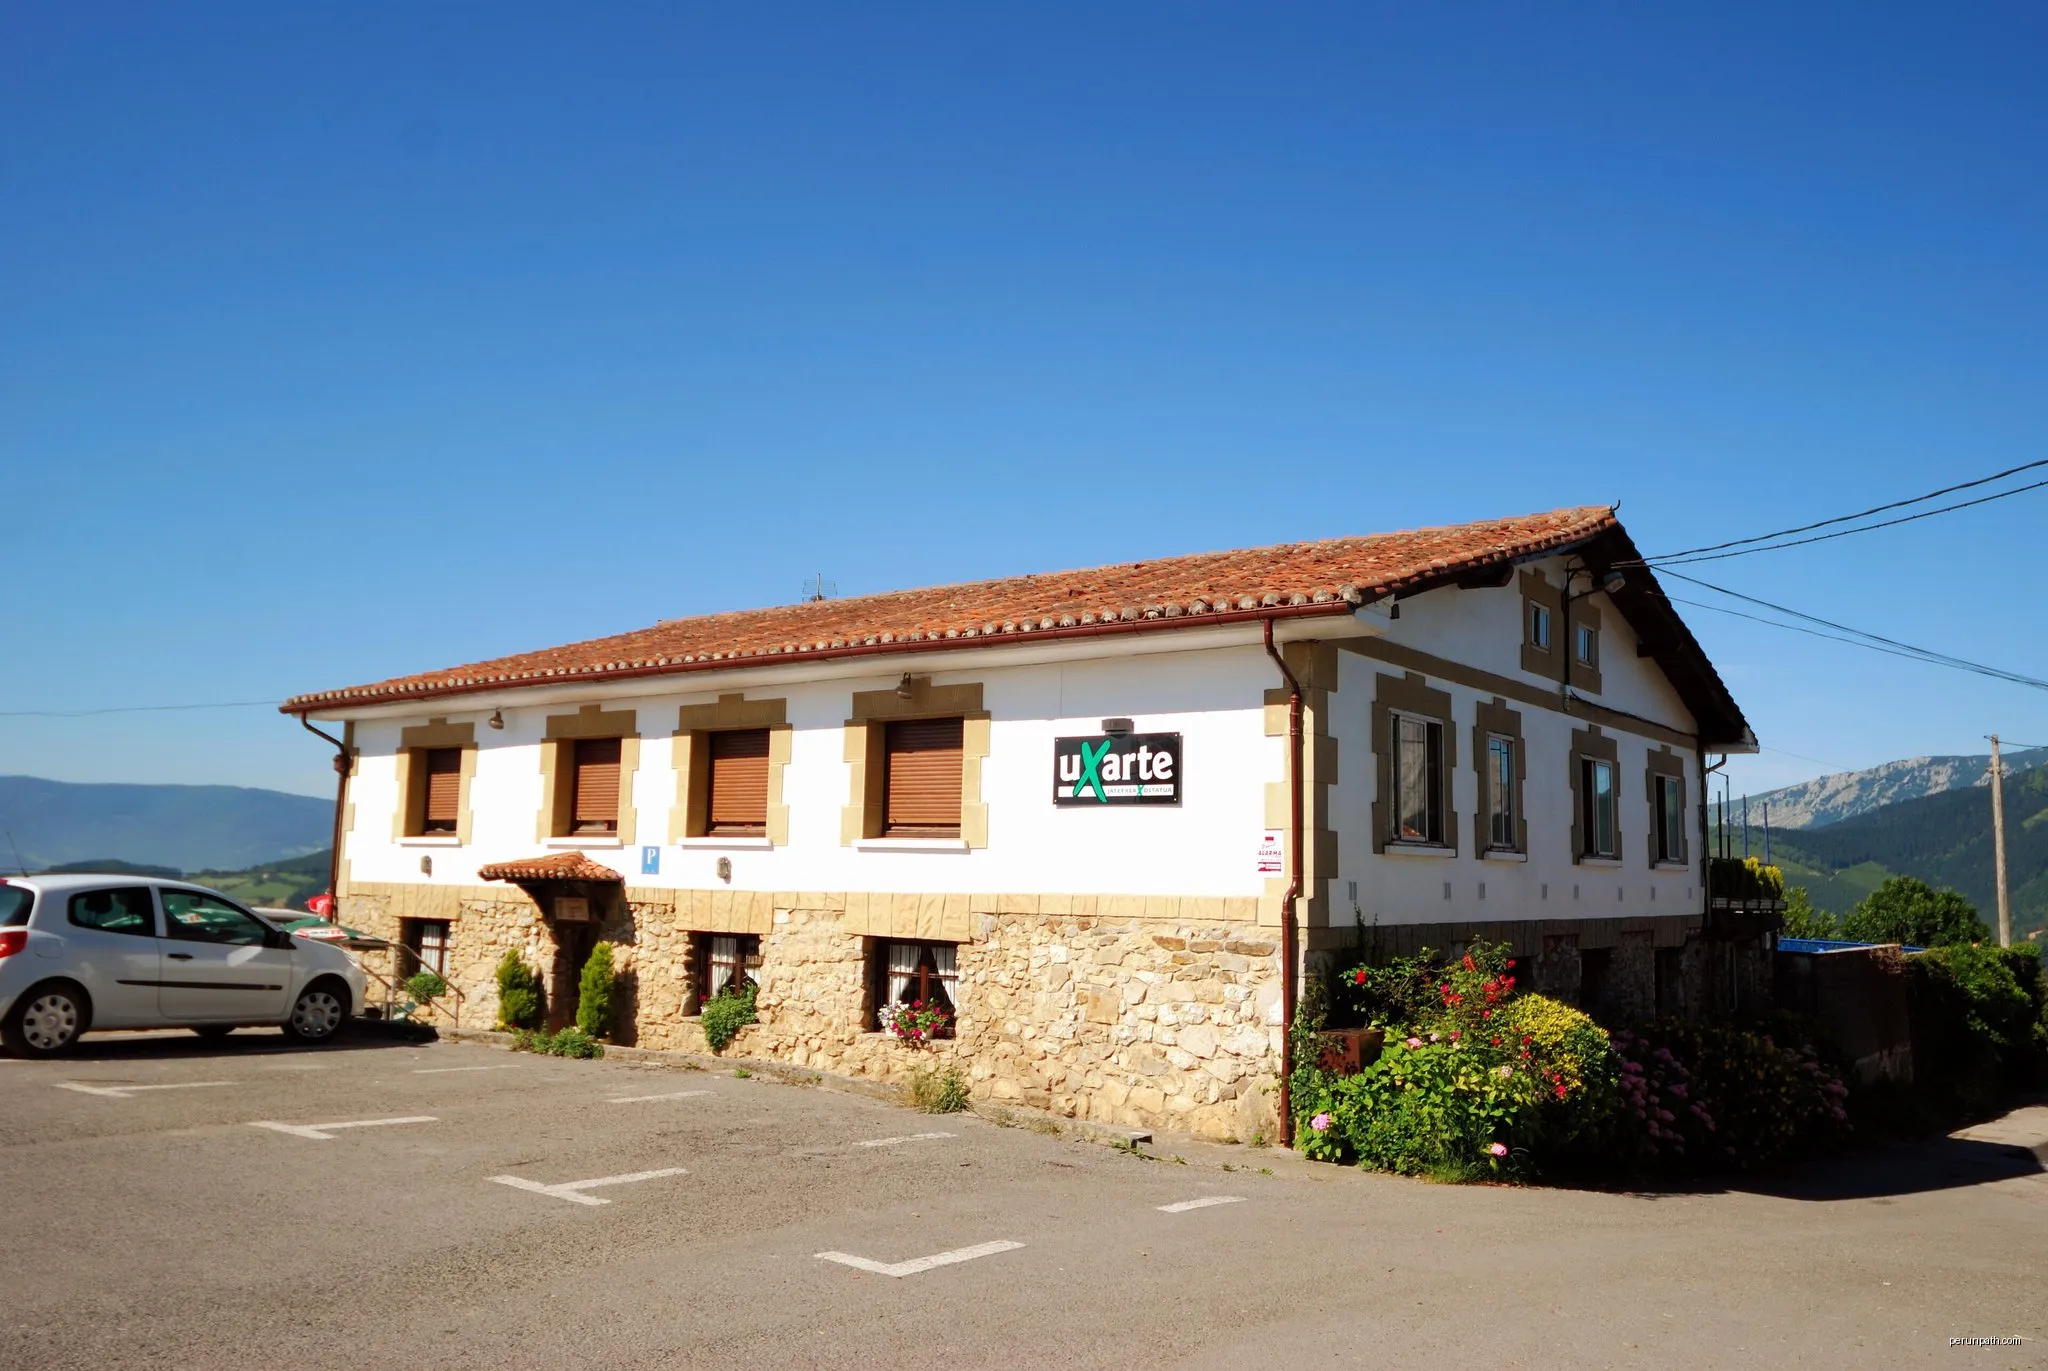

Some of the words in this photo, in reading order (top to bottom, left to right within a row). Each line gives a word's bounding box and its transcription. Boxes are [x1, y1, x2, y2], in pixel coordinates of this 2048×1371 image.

[1059, 740, 1173, 803] uXarte
[1144, 786, 1173, 794] OSTATUA
[647, 848, 656, 865] P
